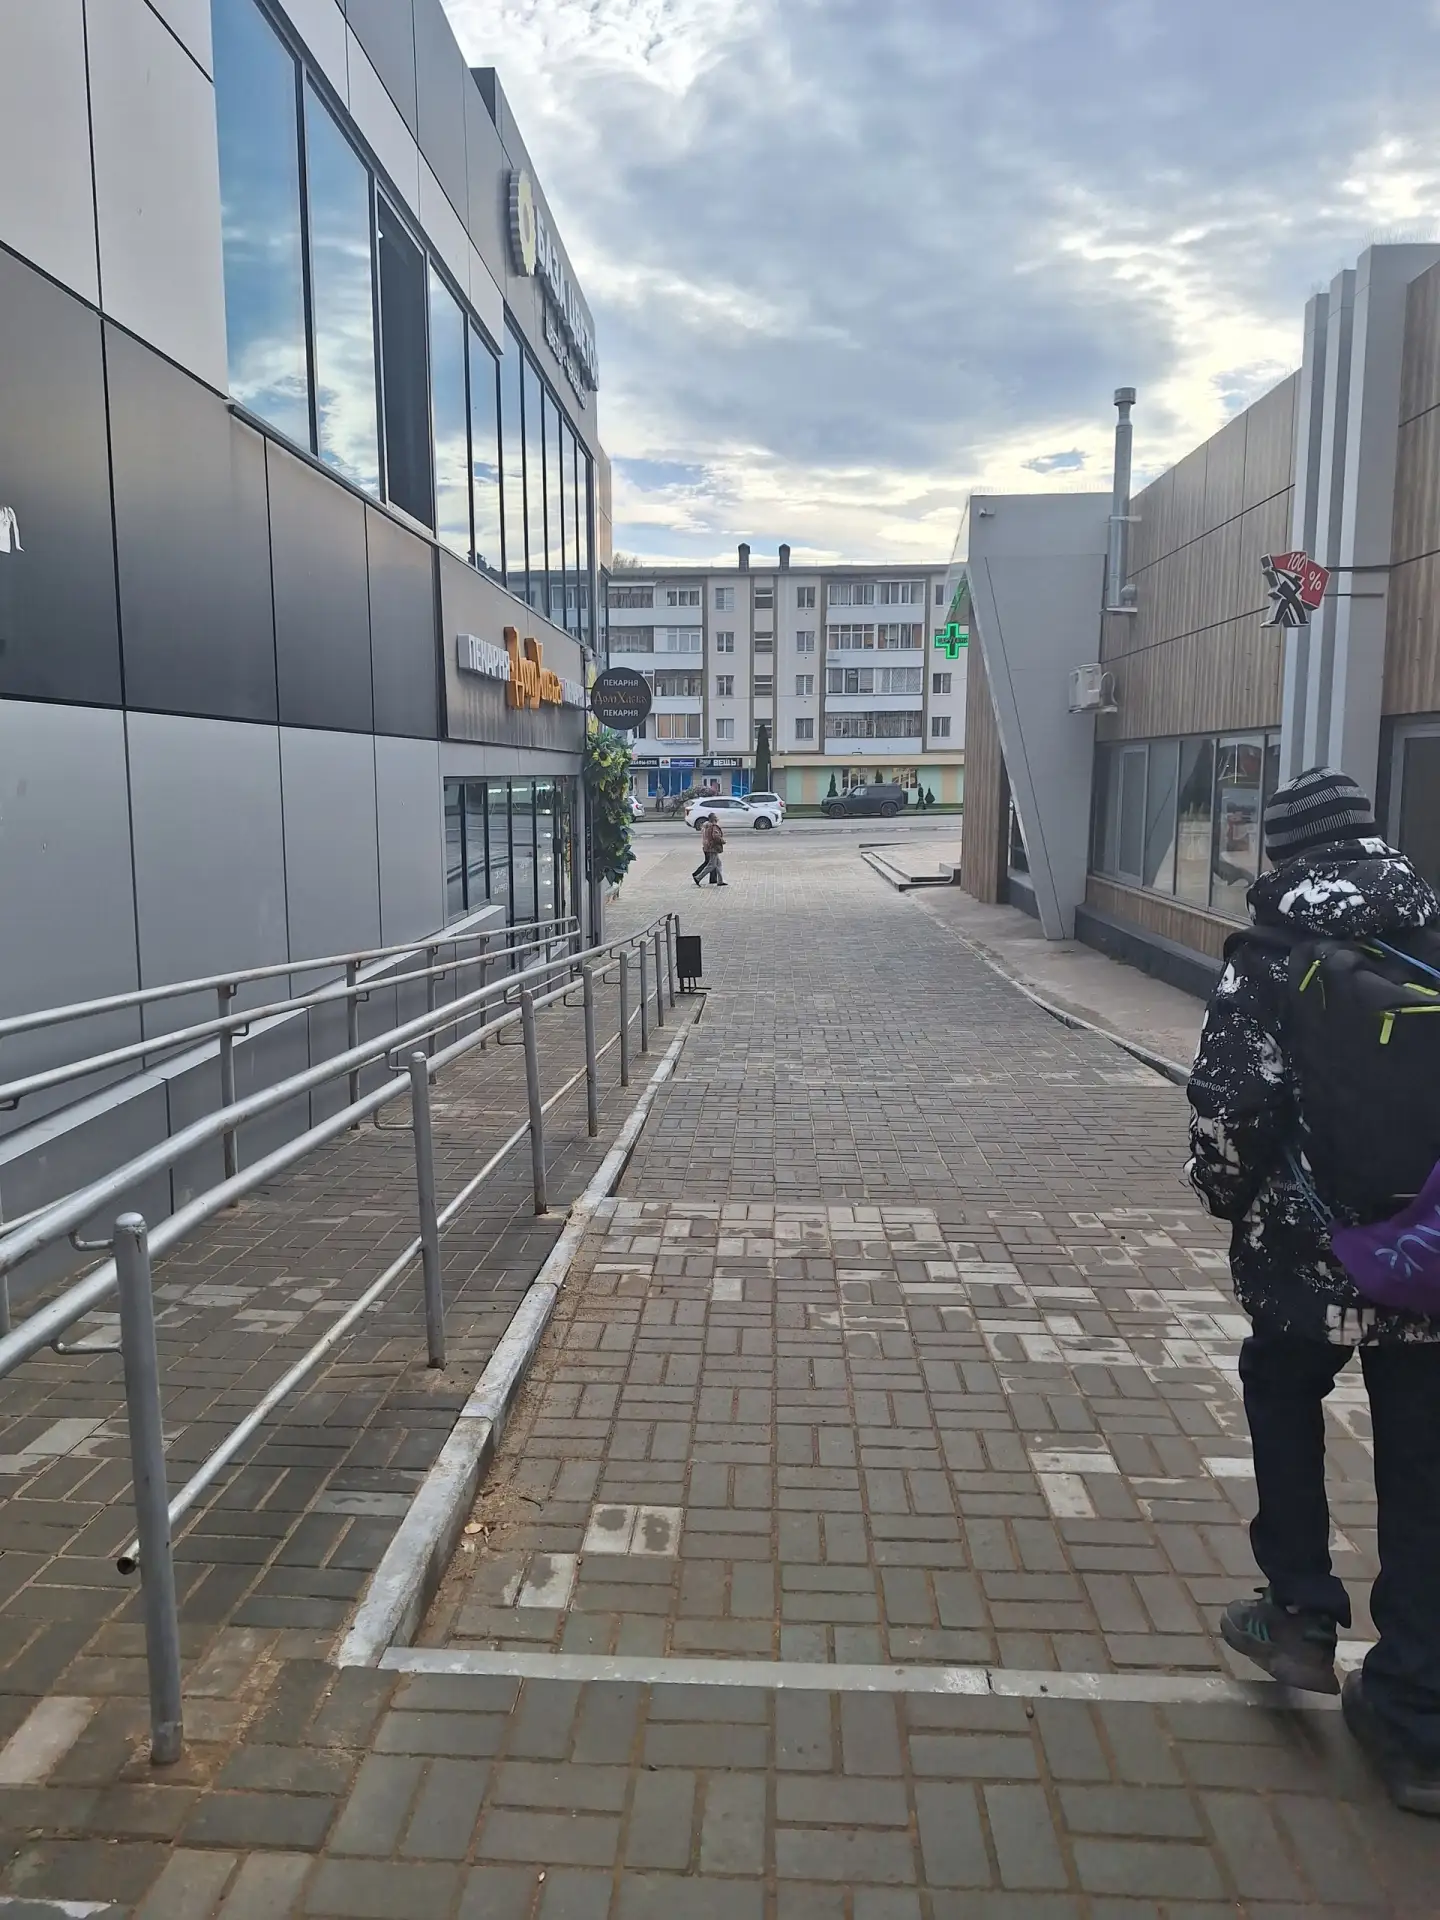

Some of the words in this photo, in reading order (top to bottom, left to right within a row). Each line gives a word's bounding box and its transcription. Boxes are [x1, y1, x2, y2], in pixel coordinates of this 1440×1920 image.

[536, 205, 567, 319] БАЗА
[1287, 553, 1306, 572] 100
[466, 634, 511, 682] ПЕКАРНЯ
[603, 679, 639, 687] ПЕКАРНЯ
[603, 709, 639, 717] ПЕКАРНЯ
